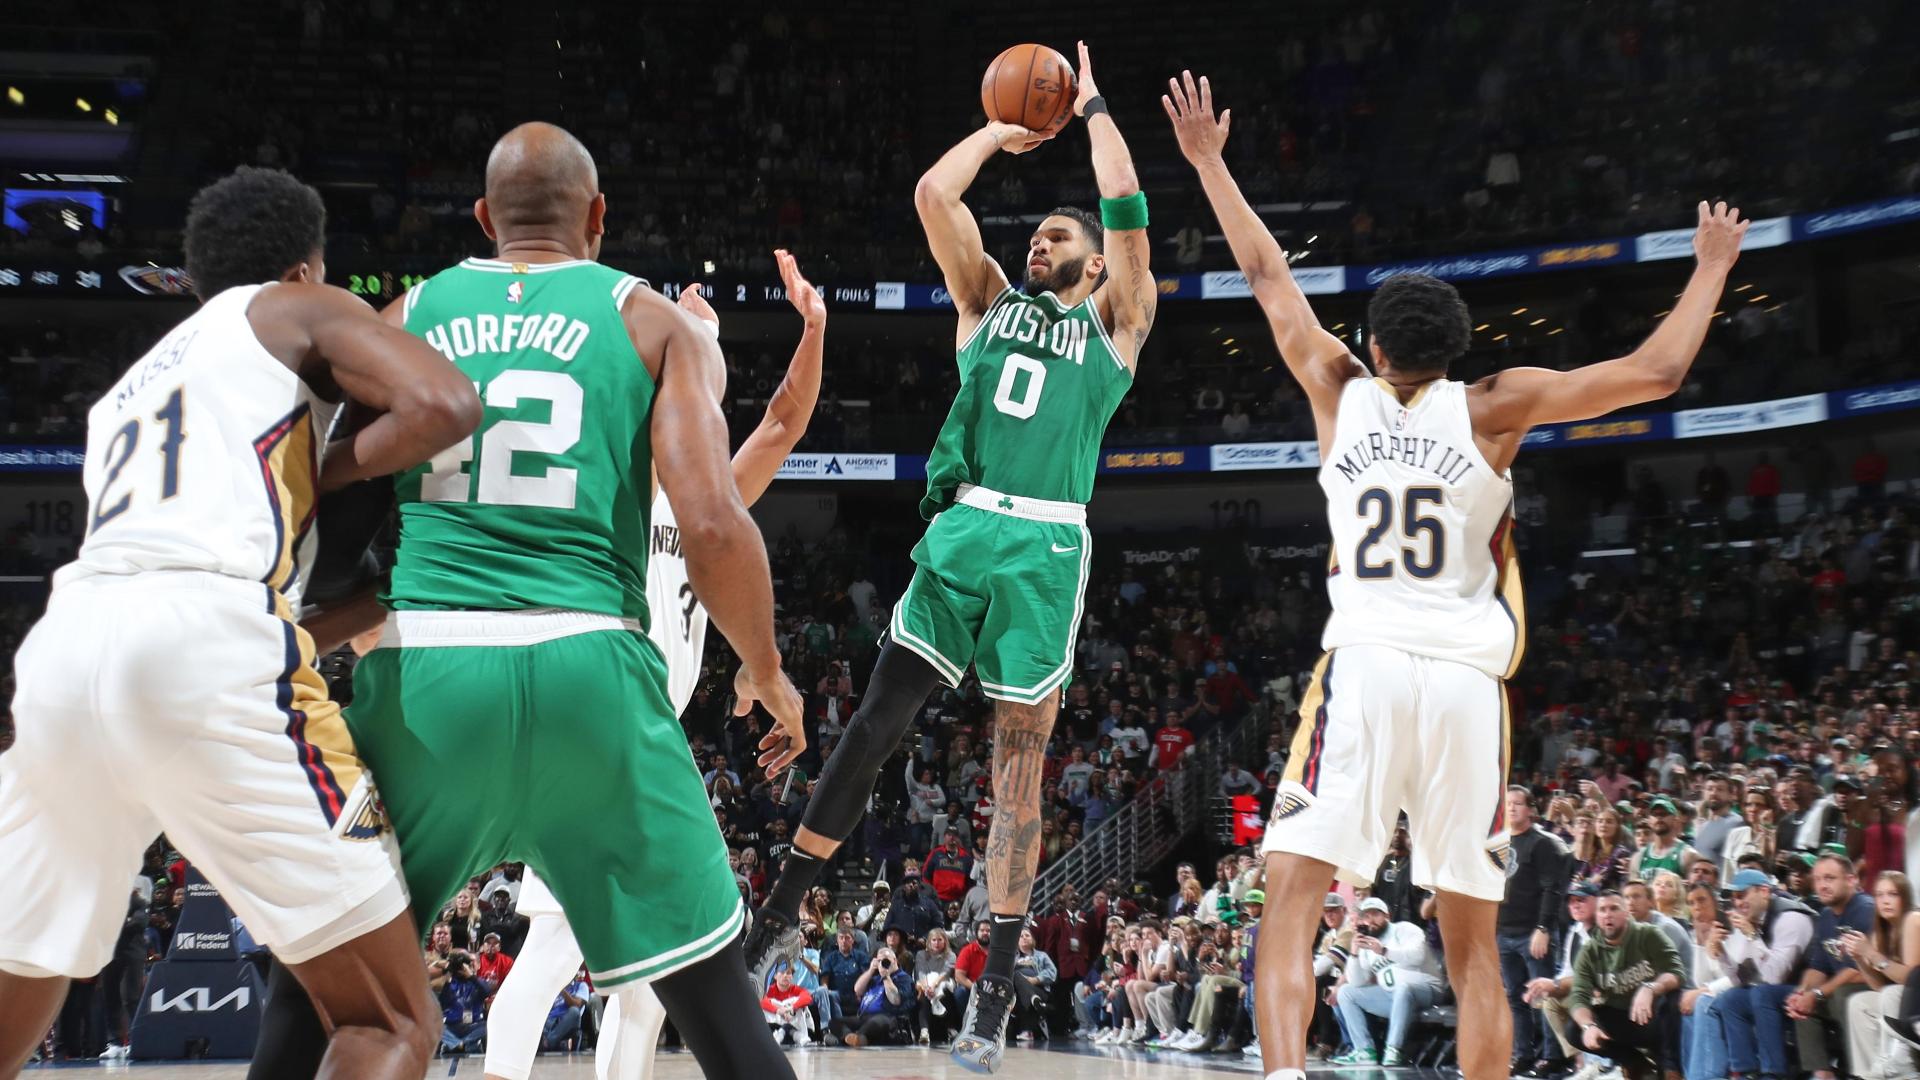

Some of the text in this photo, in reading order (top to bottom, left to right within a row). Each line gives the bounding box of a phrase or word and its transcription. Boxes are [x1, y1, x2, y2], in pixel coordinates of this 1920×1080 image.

[349, 275, 380, 295] 2.0
[737, 284, 746, 301] 2
[836, 287, 870, 302] FOULS
[931, 287, 953, 305] Ge
[425, 313, 591, 362] HORFORD
[984, 301, 1089, 366] BOSTON
[117, 329, 201, 411] MISSI
[993, 352, 1047, 420] 0
[89, 384, 188, 538] 21
[844, 457, 888, 467] ANDREWS
[1335, 432, 1474, 486] MURPHY III
[1356, 486, 1446, 581] 25
[195, 931, 231, 941] Keesler
[195, 940, 230, 950] Federal
[150, 986, 250, 1013] KIA
